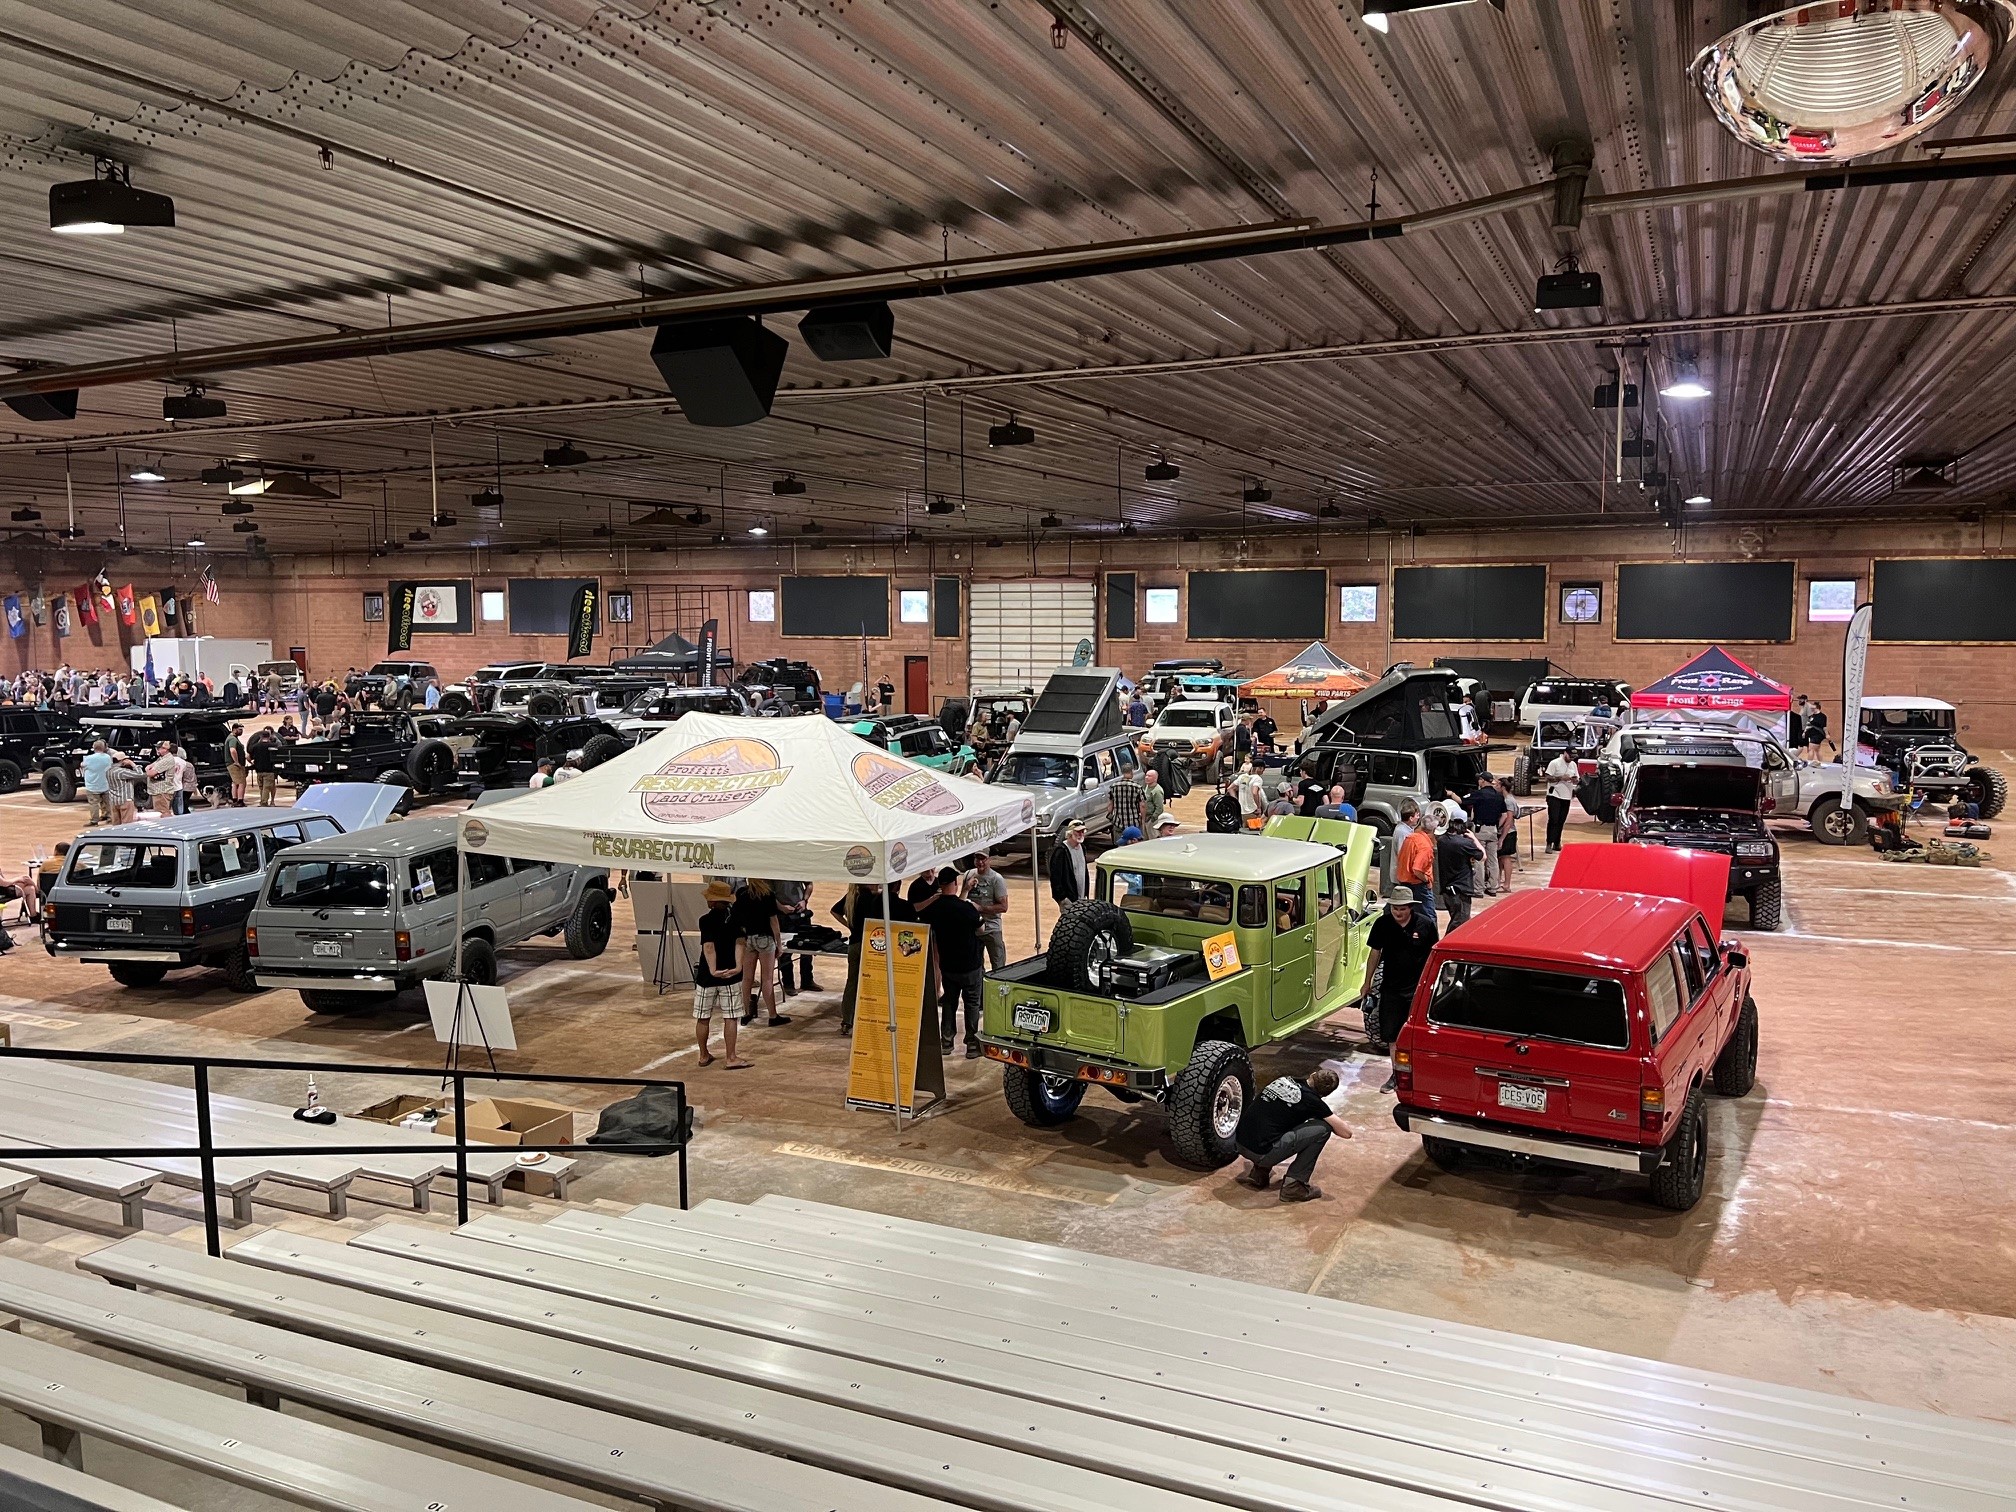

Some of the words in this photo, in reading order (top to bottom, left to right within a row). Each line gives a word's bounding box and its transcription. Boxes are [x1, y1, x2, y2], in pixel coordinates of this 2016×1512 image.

[705, 637, 713, 662] FRONT
[1671, 677, 1699, 685] Front
[1722, 676, 1754, 686] Range
[1331, 690, 1352, 698] PARTS
[1666, 694, 1695, 706] Front
[1711, 694, 1745, 707] Range
[634, 769, 789, 792] RESURRECTION
[650, 791, 690, 804] Land
[690, 788, 759, 804] Cruisers
[932, 814, 999, 856] RESURRECTION
[592, 837, 715, 864] RESURRECTION
[705, 862, 736, 871] Cruisers
[887, 1159, 978, 1182] SLIPPERY
[744, 1412, 756, 1420] 10
[222, 1439, 238, 1448] 11
[610, 1449, 624, 1458] 10
[427, 1502, 444, 1512] 10
